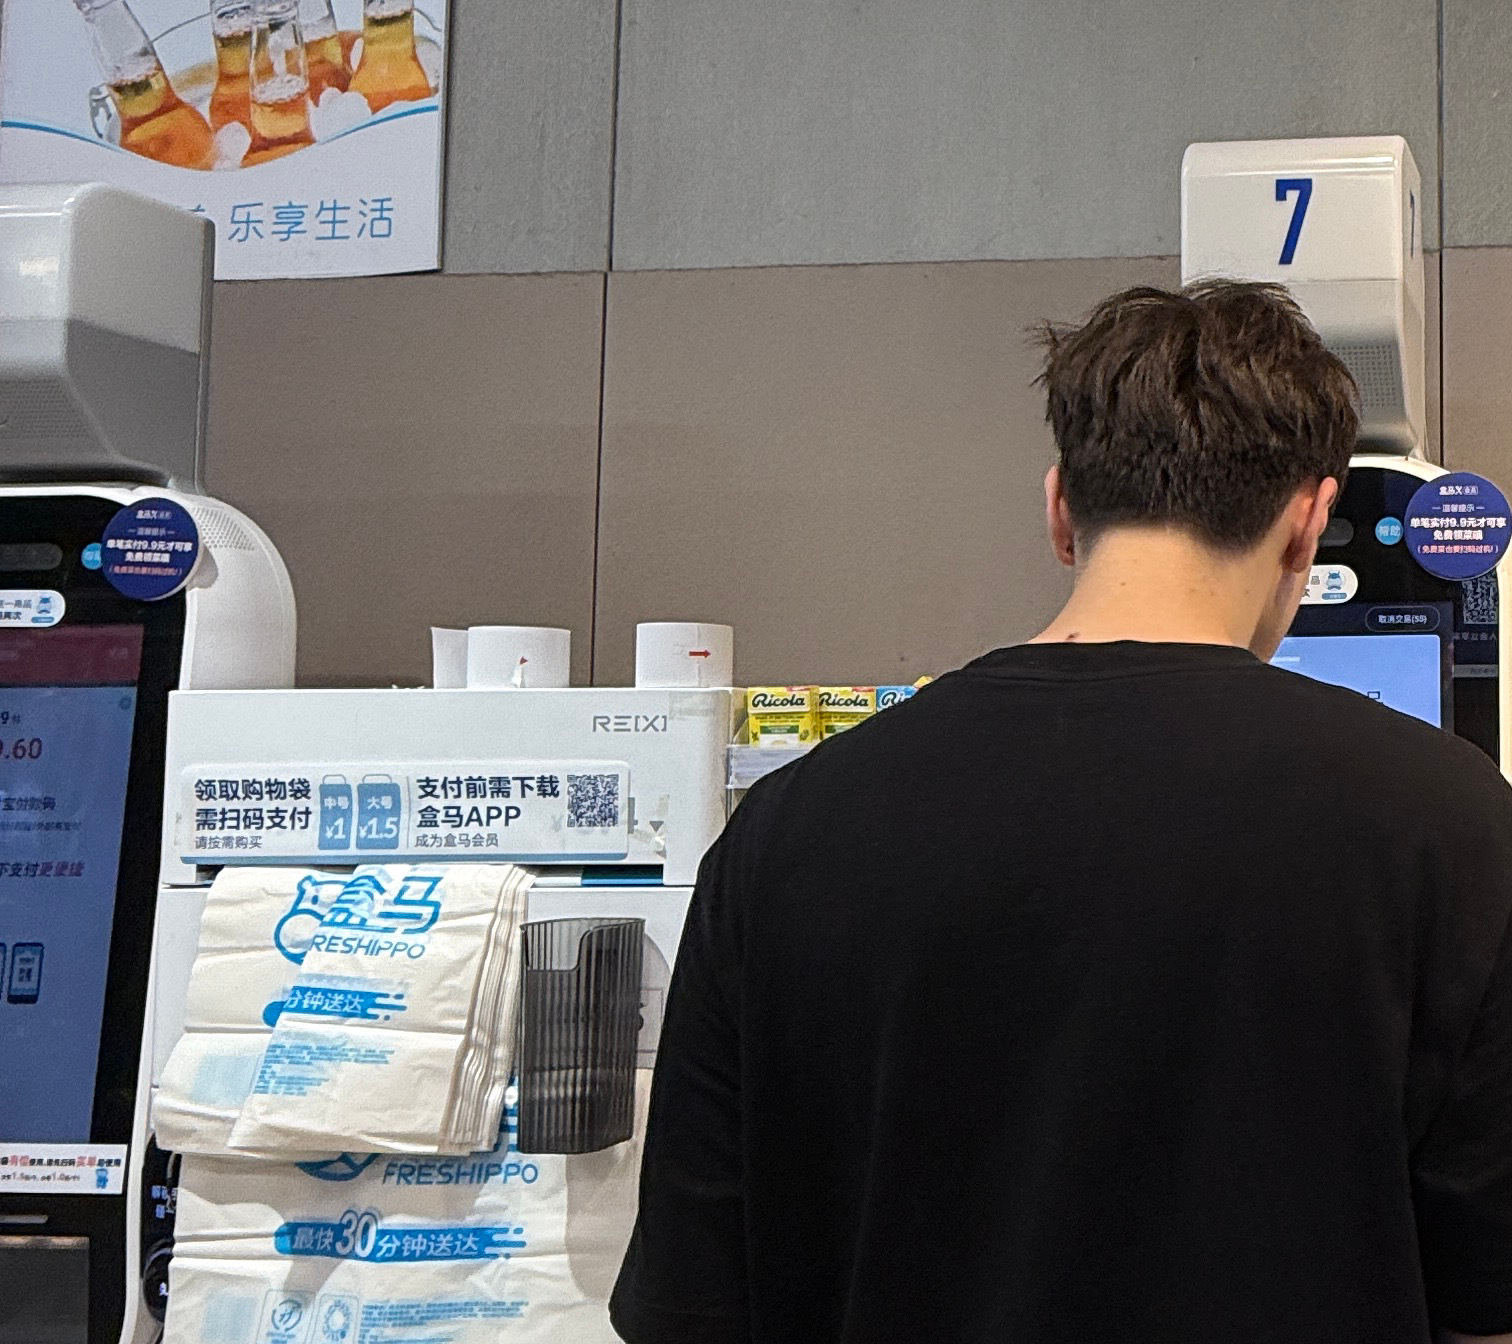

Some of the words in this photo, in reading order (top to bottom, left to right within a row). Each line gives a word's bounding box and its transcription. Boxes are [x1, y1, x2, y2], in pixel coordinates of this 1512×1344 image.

[227, 197, 394, 243] 乐享生活
[1275, 178, 1313, 266] 7
[752, 693, 806, 707] Ricola
[819, 692, 869, 707] Ricola
[0, 738, 43, 759] .60
[194, 778, 311, 801] 领取购物袋
[417, 775, 560, 800] 支付前需下载
[367, 796, 392, 810] 大号
[196, 807, 312, 831] 需扫码支付
[325, 818, 346, 839] ¥1
[359, 817, 398, 839] ¥1.5
[417, 805, 521, 829] 盒马APP
[195, 836, 262, 849] 请按需购买
[415, 833, 498, 849] 成为盒马会员
[322, 872, 443, 935] 盒马
[308, 934, 427, 959] RESHIPPO
[380, 1160, 539, 1187] FRESHIPPO
